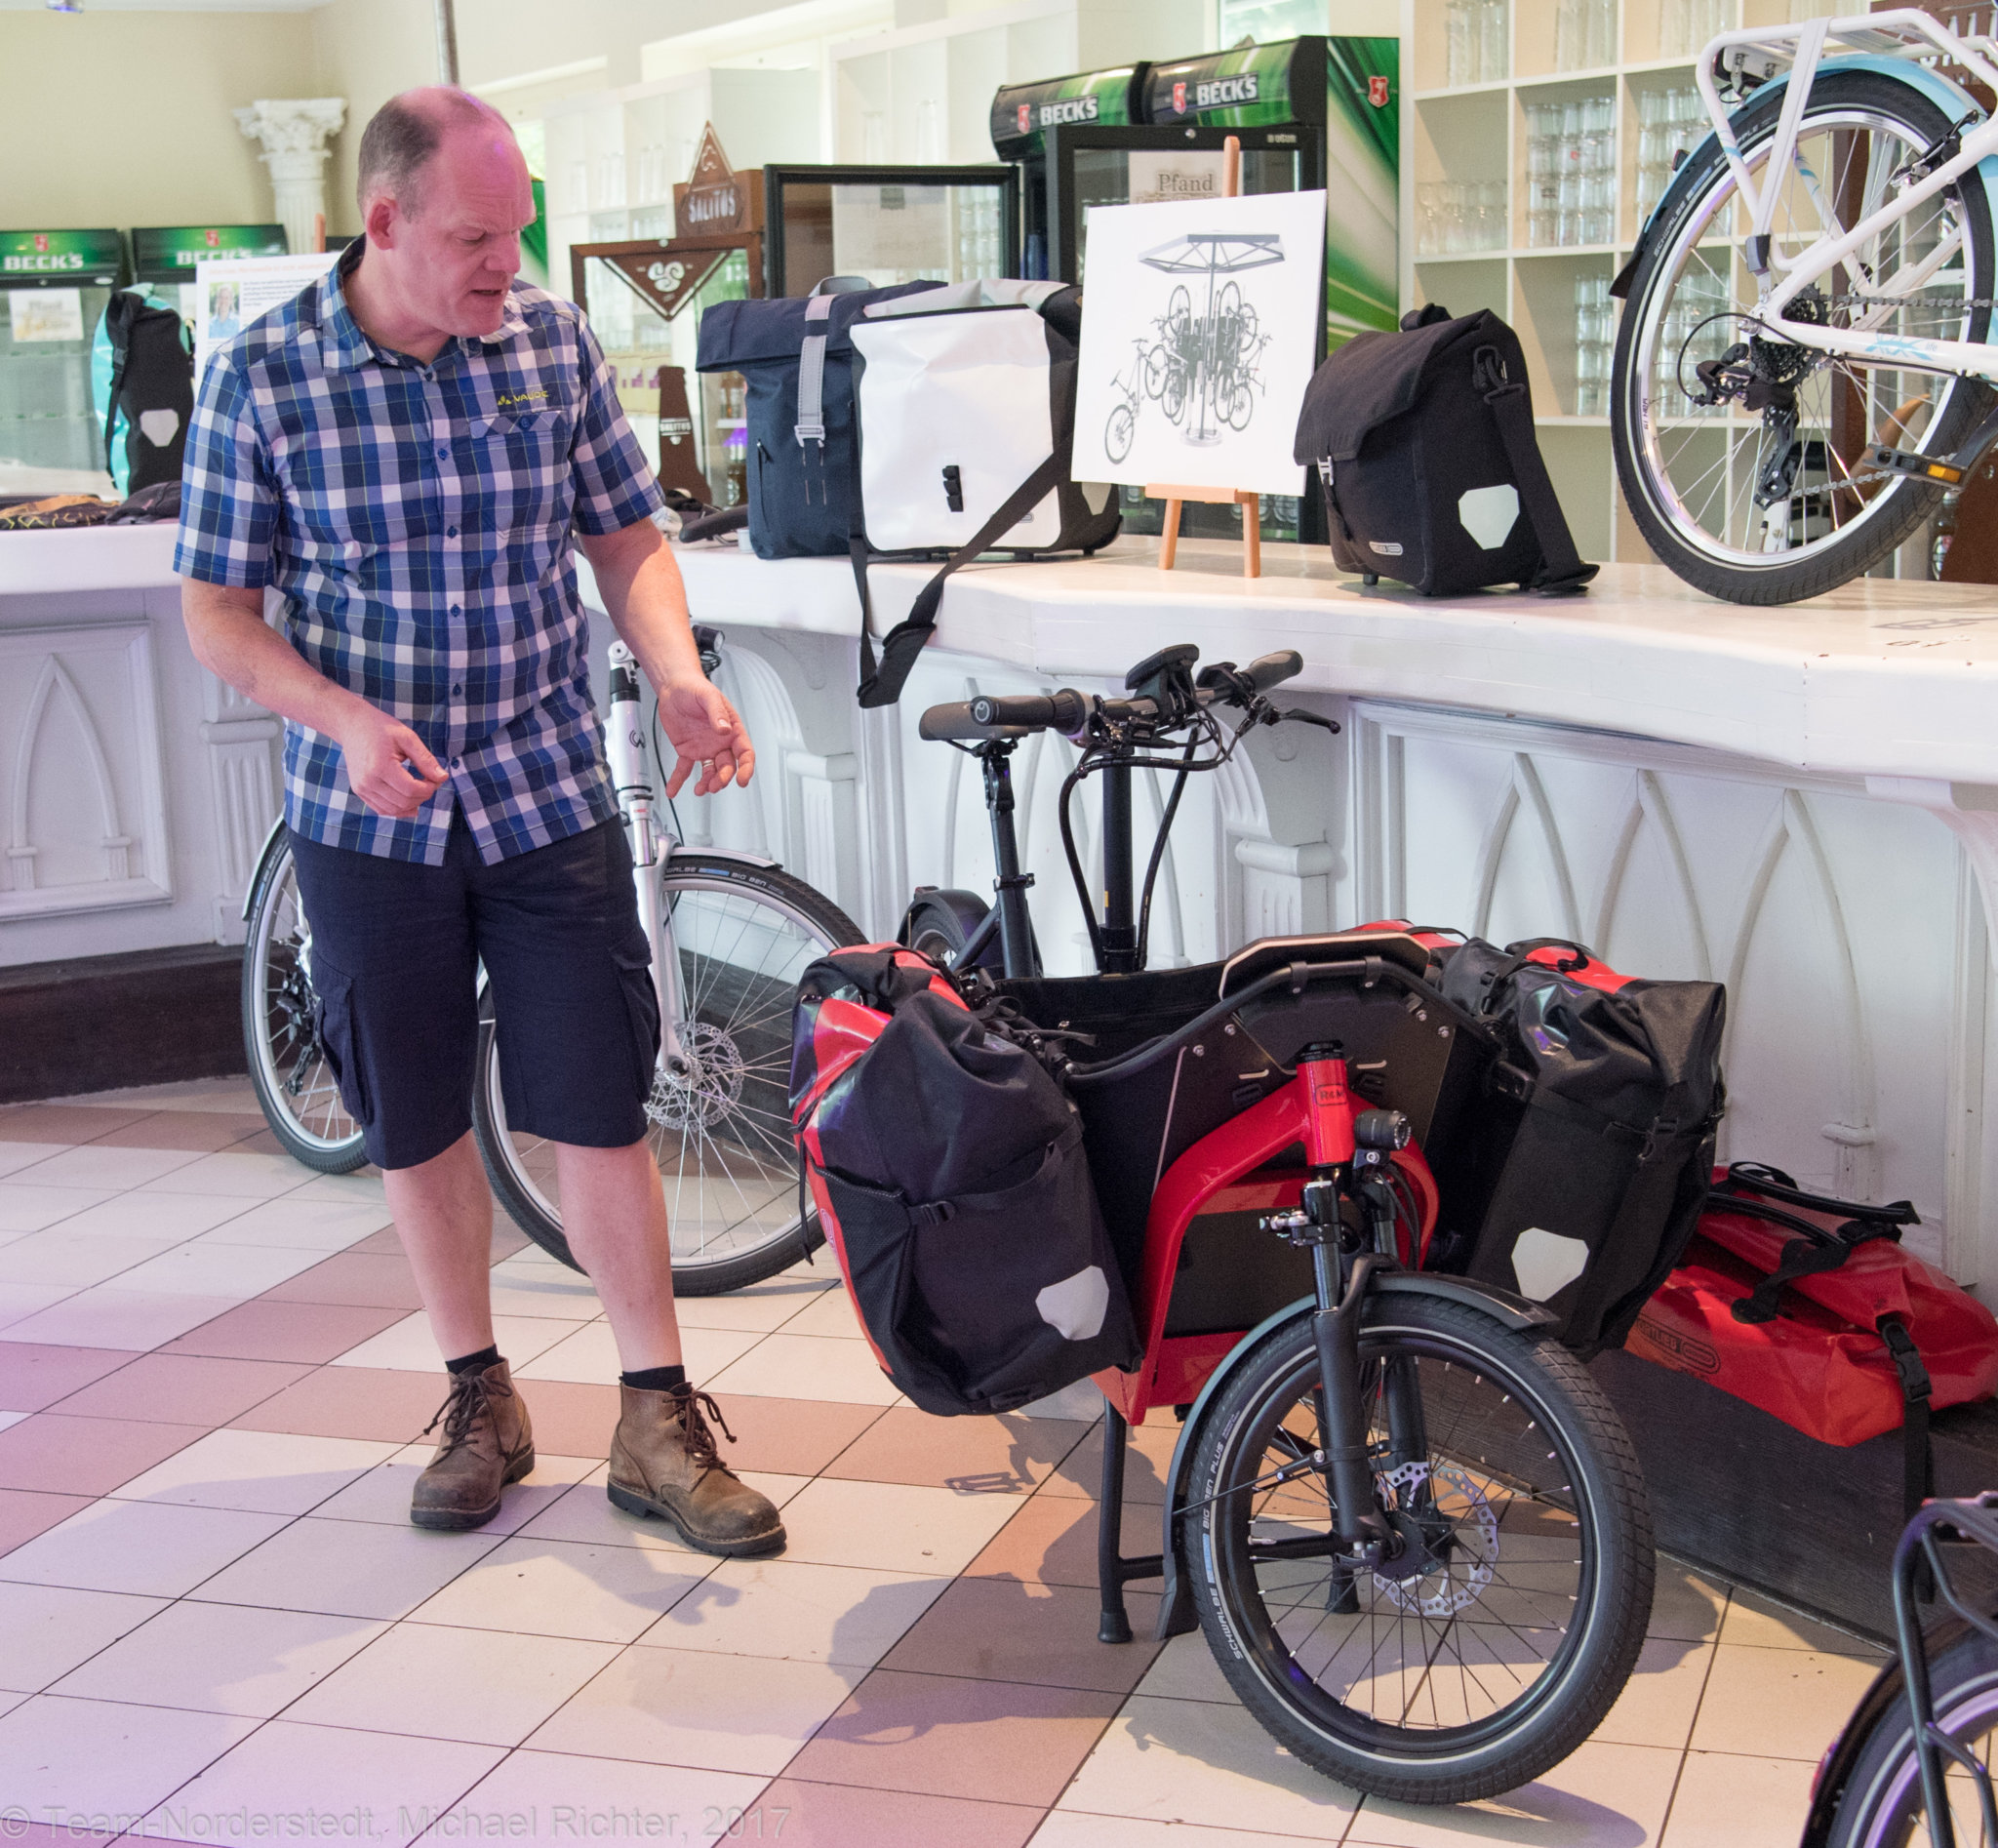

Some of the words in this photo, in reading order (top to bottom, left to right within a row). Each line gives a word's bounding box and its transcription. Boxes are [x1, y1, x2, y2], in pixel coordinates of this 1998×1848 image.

[1196, 75, 1258, 106] BECK'S
[1040, 97, 1098, 127] BECK'S
[1158, 174, 1214, 191] Pfand
[689, 187, 737, 223] SALITOS
[1654, 201, 1687, 257] SCHWALBE
[4, 252, 84, 271] BECK'S
[177, 247, 253, 266] BECK'S
[513, 390, 549, 402] VAUDE
[731, 871, 747, 880] BIG
[1211, 1441, 1225, 1474] PLUS
[1210, 1587, 1244, 1660] SCHWALBE
